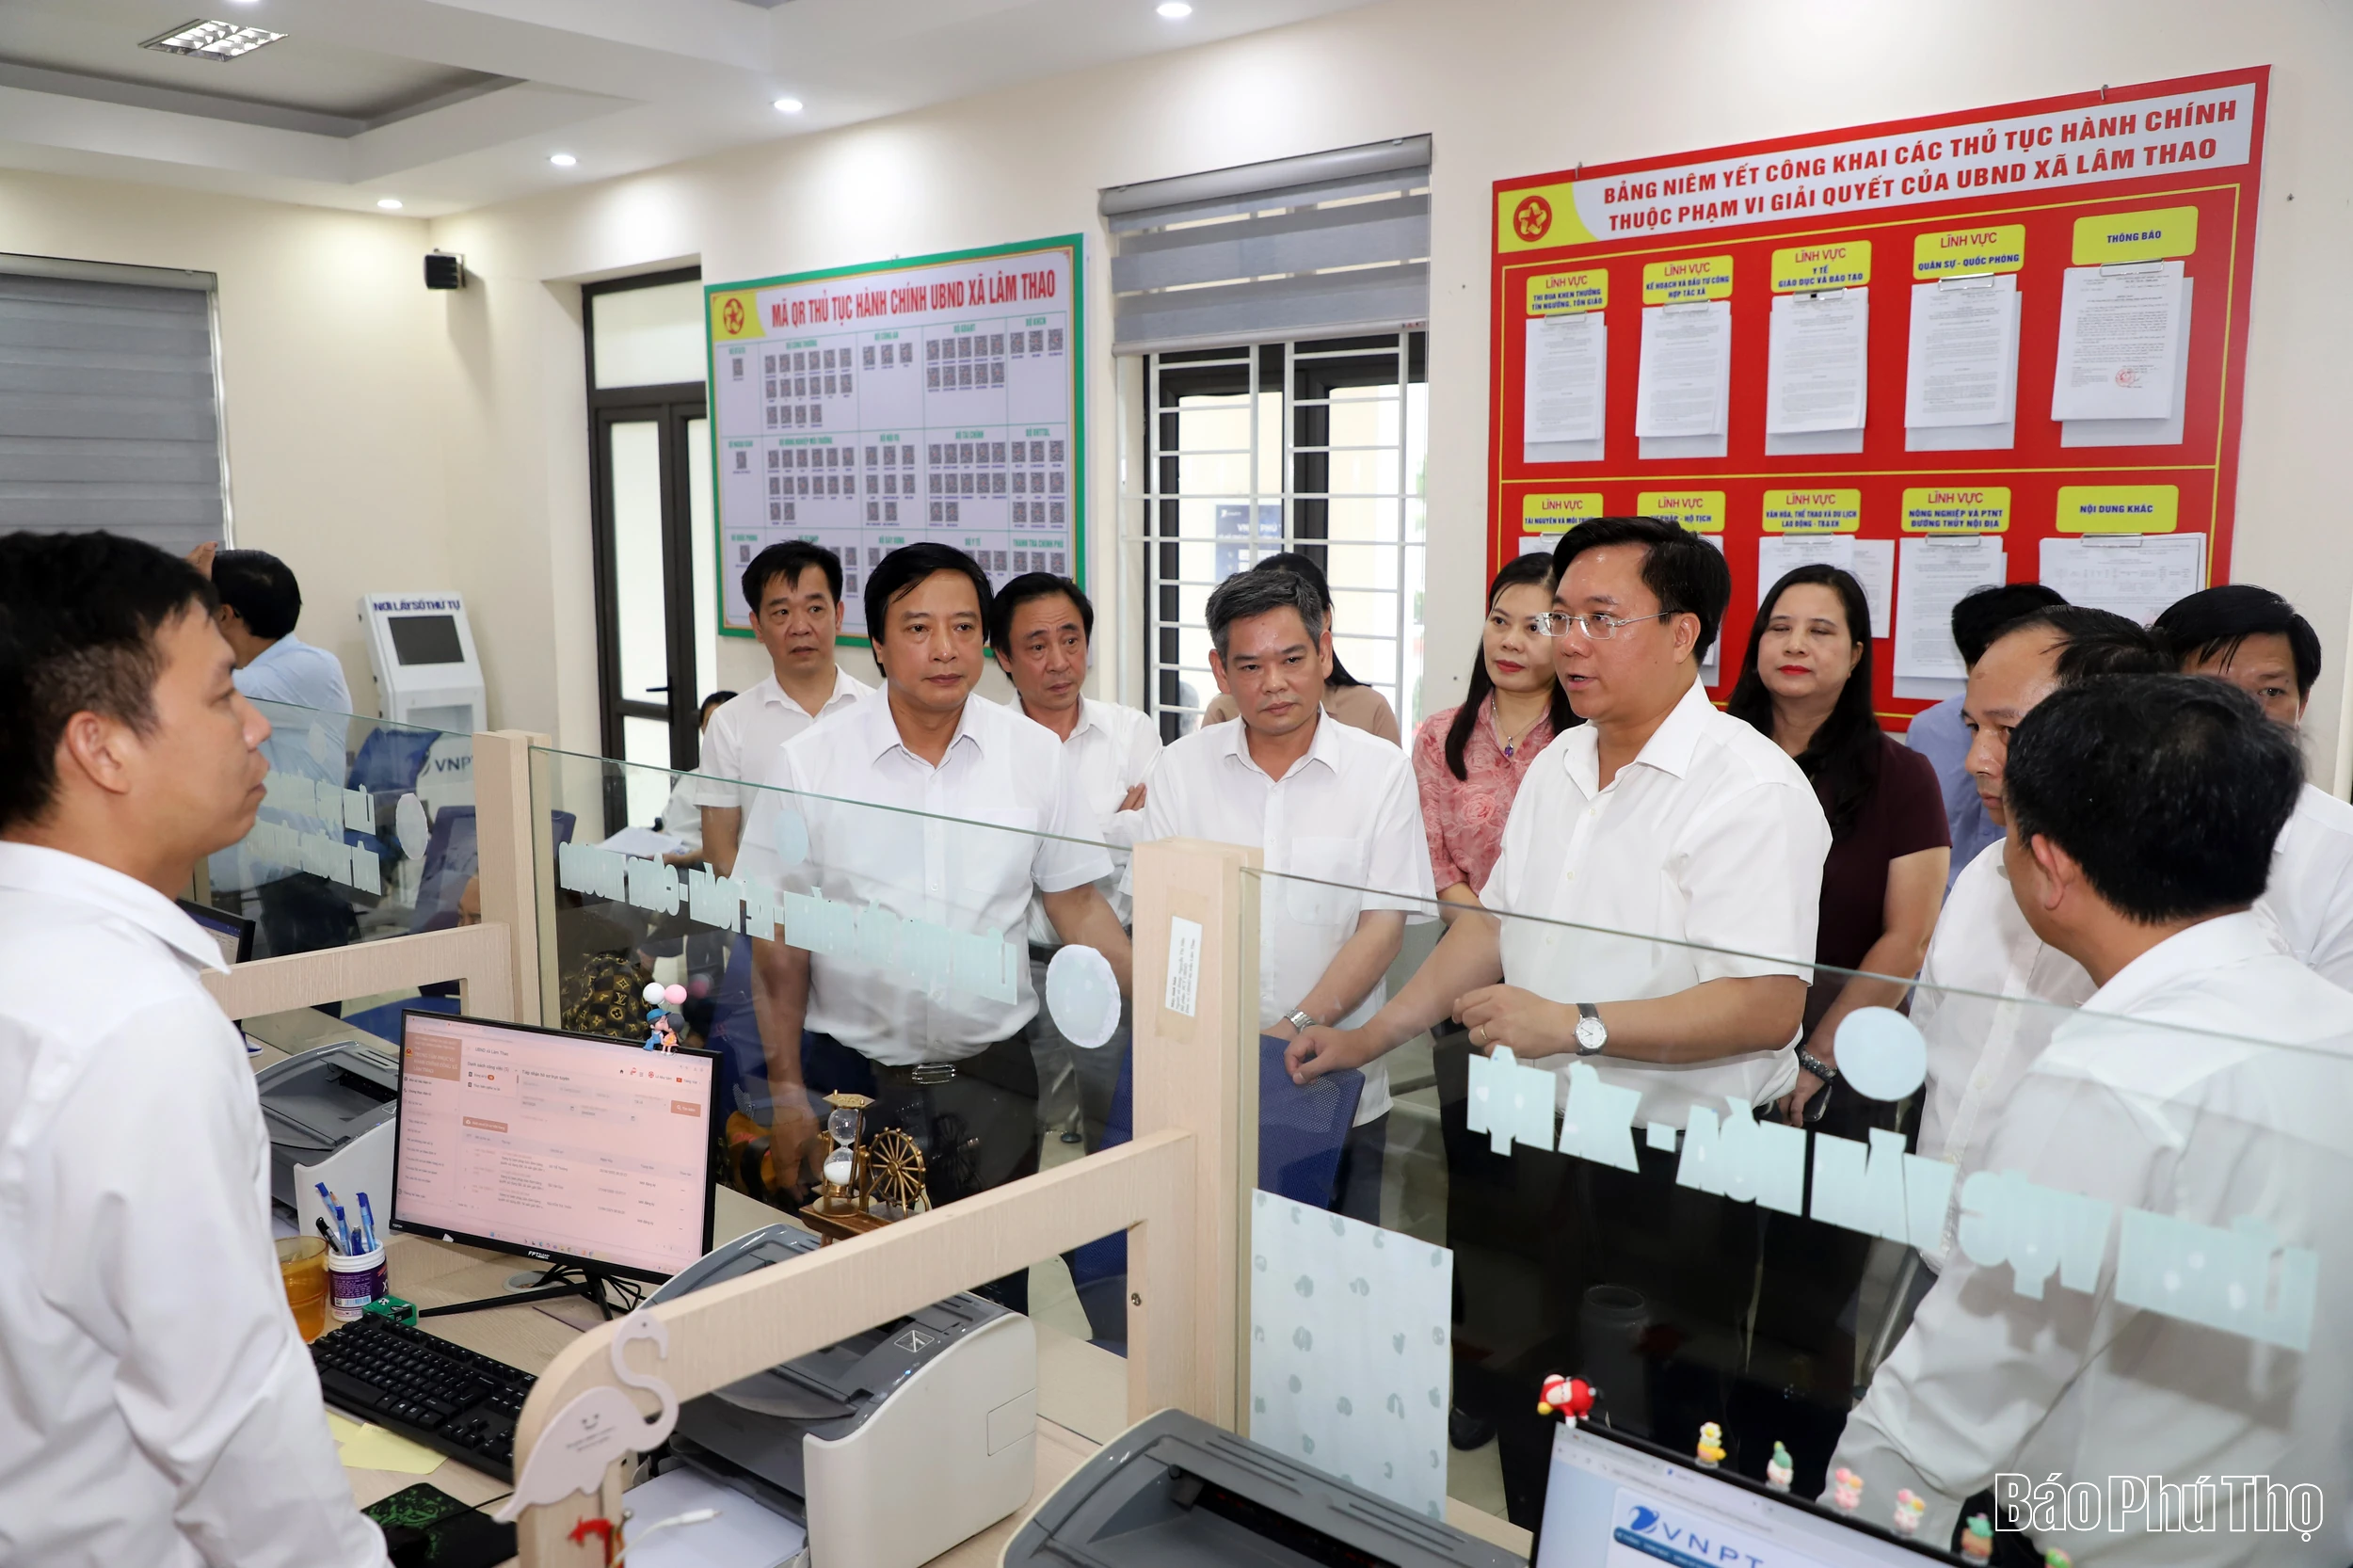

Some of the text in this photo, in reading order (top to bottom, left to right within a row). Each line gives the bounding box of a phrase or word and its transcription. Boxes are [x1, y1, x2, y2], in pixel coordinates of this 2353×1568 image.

[1604, 100, 2236, 204] BẢNG NIÊM YẾT CÔNG KHAI CÁC THỦ TỤC HÀNH CHÍNH
[1609, 138, 2217, 232] THUỘC PHẠM VI GIẢI QUYẾT CỦA UBND XÃ LÂM THAO
[1940, 232, 1997, 248] LĨNH VỰC
[2107, 230, 2162, 244] THÔNG BÁO
[1795, 248, 1846, 264] LĨNH VỰC
[1918, 260, 1942, 271] QUÂN
[1944, 259, 1957, 270] SỰ
[1962, 255, 1986, 267] QUỐC
[1989, 253, 2020, 264] PHÒNG
[1664, 262, 1710, 277] LĨNH VỰC
[1545, 275, 1589, 289] LĨNH VỰC
[1778, 277, 1798, 288] GIÁO
[1799, 277, 1816, 287] DỤC
[772, 269, 1056, 328] MÃ QR THỦ TỤC HÀNH CHÍNH UBND XÃ LÂM THAO
[1542, 498, 1583, 511] LĨNH VỰC
[1658, 496, 1704, 509] LĨNH VỰC
[1786, 492, 1836, 506] LĨNH VỰC
[1928, 490, 1983, 506] LĨNH VỰC
[1968, 508, 1979, 517] VÀ
[2080, 504, 2096, 515] NỘI
[2126, 504, 2153, 513] KHÁC
[1967, 519, 1982, 528] NỘI
[435, 756, 473, 773] VNP
[1662, 1522, 1765, 1568] VNPT
